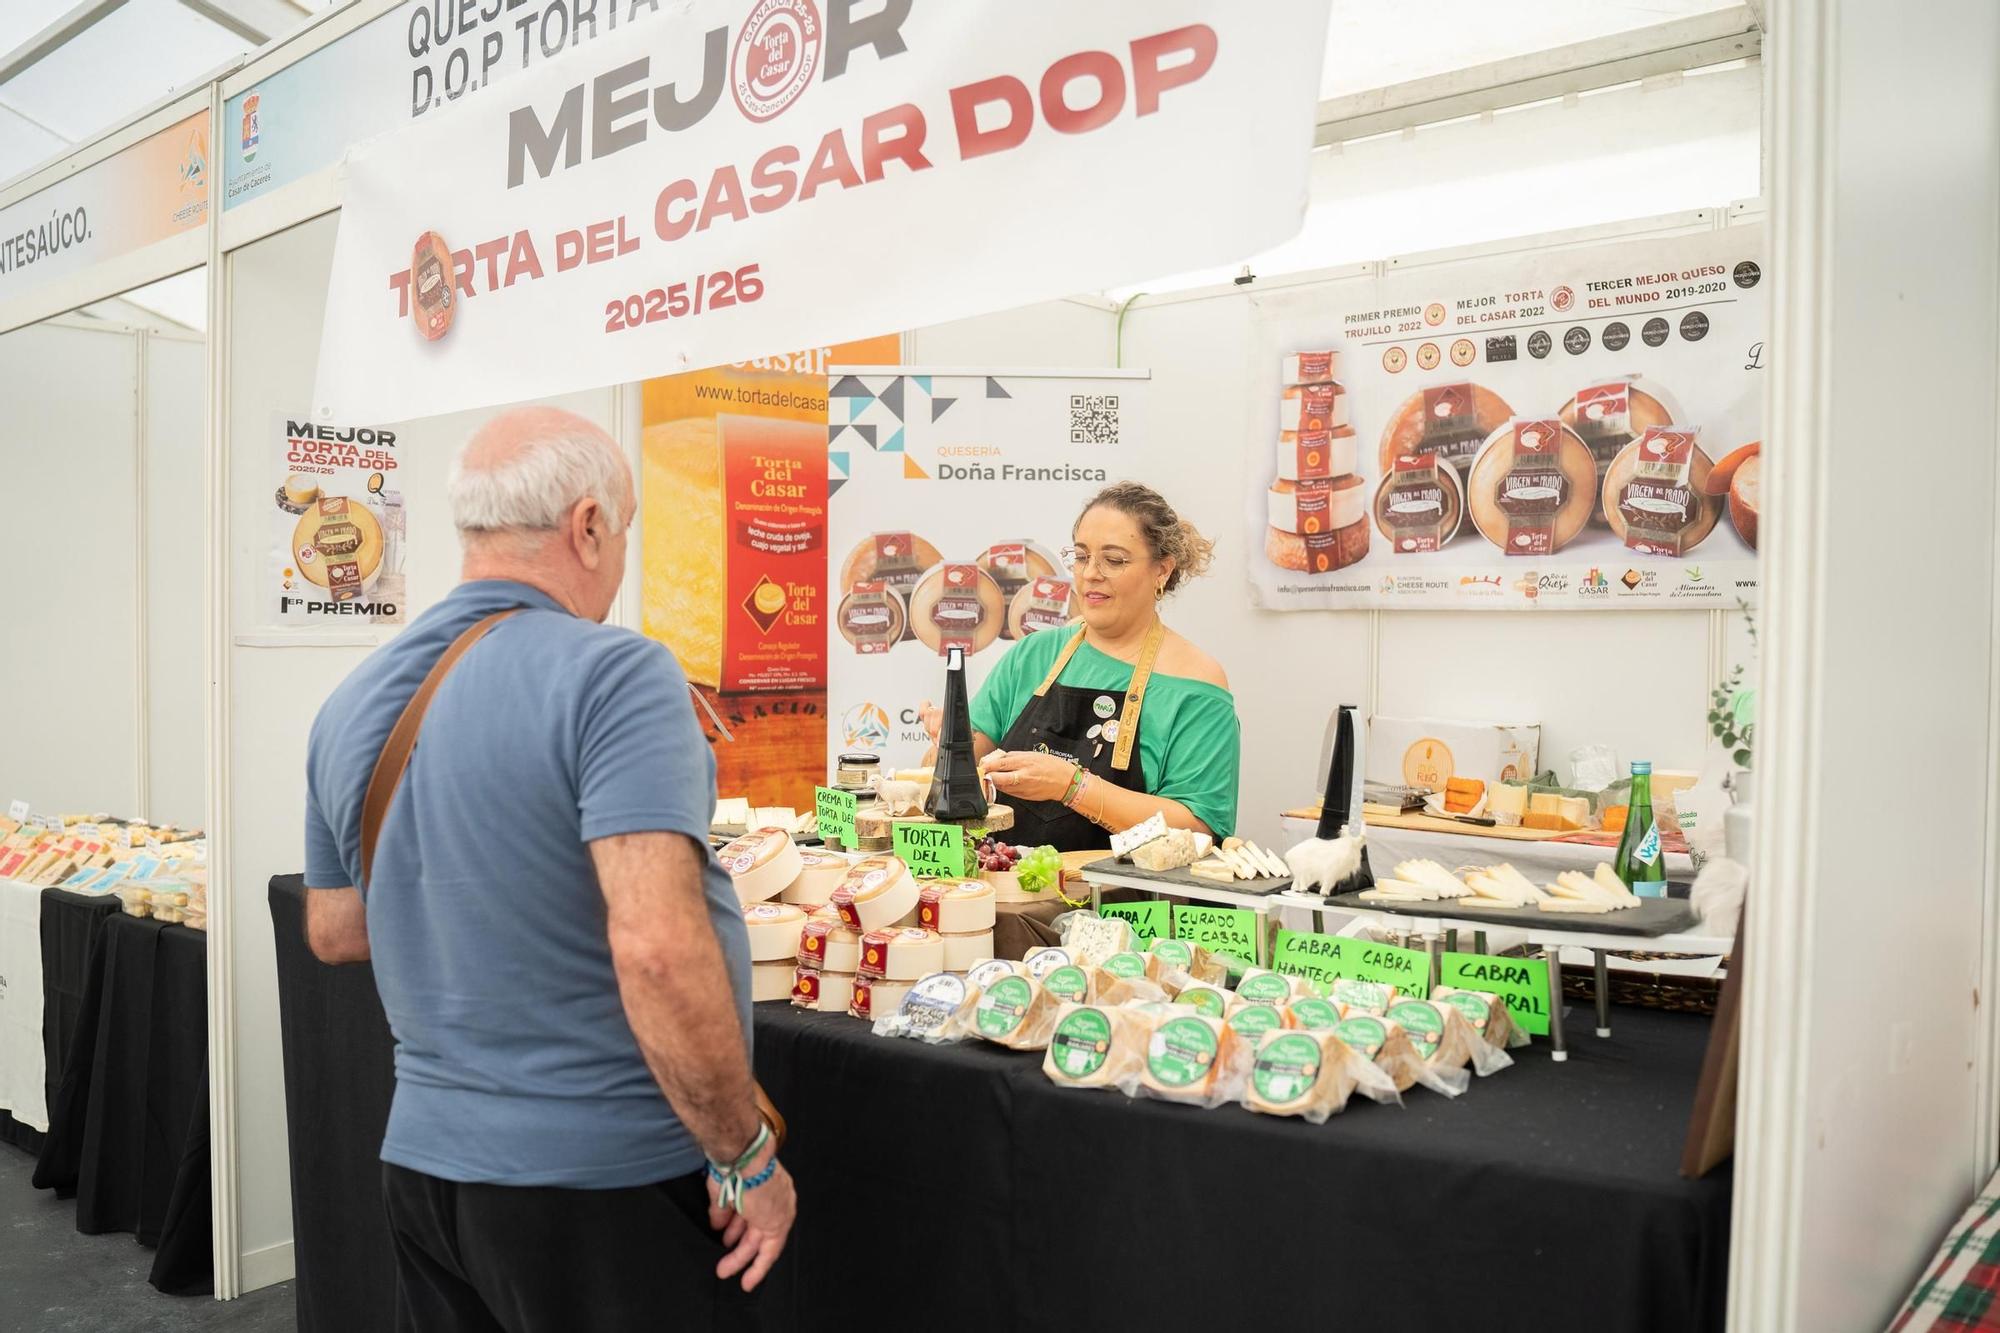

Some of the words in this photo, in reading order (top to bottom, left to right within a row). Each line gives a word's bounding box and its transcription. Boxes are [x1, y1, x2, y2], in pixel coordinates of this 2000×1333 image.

[764, 32, 789, 51] Torta
[768, 44, 783, 63] del
[760, 60, 791, 80] Casar
[555, 214, 641, 274] DEL
[654, 103, 934, 243] CASAR
[948, 23, 1219, 161] DOP
[1586, 278, 1633, 292] TERCER
[1635, 273, 1679, 287] MEJOR
[1681, 265, 1726, 281] QUESO
[605, 263, 765, 334] 2025/26
[1456, 296, 1497, 310] MEJOR
[1504, 290, 1545, 303] TORTA
[1588, 298, 1611, 309] DEL
[1615, 291, 1660, 306] MUNDO
[1665, 281, 1727, 300] 2019-2020
[1344, 310, 1380, 325] PRIMER
[1383, 305, 1422, 319] PREMIO
[1456, 315, 1477, 325] DEL
[1480, 310, 1517, 322] CASAR
[1519, 306, 1545, 318] 2022
[1344, 325, 1392, 339] TRUJILLO
[1398, 321, 1422, 333] 2022
[286, 420, 397, 448] MEJOR
[287, 438, 360, 458] TORTA
[365, 449, 395, 461] DEL
[937, 445, 1001, 458] QUESERÍA
[287, 452, 355, 469] CASAR
[358, 458, 398, 472] DOP
[288, 464, 336, 475] 2025/26
[751, 456, 803, 469] Torta
[764, 468, 792, 481] del
[937, 462, 996, 481] Doña
[1002, 464, 1106, 482] Francisca
[750, 480, 807, 498] Casar
[1505, 476, 1531, 489] VIRGEN
[1539, 475, 1563, 490] PRADO
[1388, 493, 1413, 505] VIRGEN
[1420, 488, 1442, 502] PRADO
[1627, 483, 1654, 499] VIRGEN
[1664, 488, 1690, 507] PRADO
[785, 582, 816, 597] Torta
[1425, 581, 1449, 589] ROUTE
[1538, 575, 1569, 591] Queso
[1578, 586, 1609, 595] CASAR
[307, 602, 398, 616] PREMIO
[793, 597, 810, 612] del
[785, 611, 818, 626] Casar
[817, 791, 842, 807] CREMA
[845, 797, 853, 809] DE
[818, 805, 839, 821] TORTA
[841, 814, 855, 825] DEL
[819, 821, 844, 837] CASAR
[899, 827, 951, 848] TORTA
[913, 849, 941, 863] DEL
[1179, 912, 1236, 929] CURADO
[1177, 926, 1195, 940] DE
[1201, 931, 1250, 945] CABRA
[1286, 937, 1342, 960] CABRA
[1362, 950, 1413, 974] CABRA
[1458, 963, 1532, 985] CABRA
